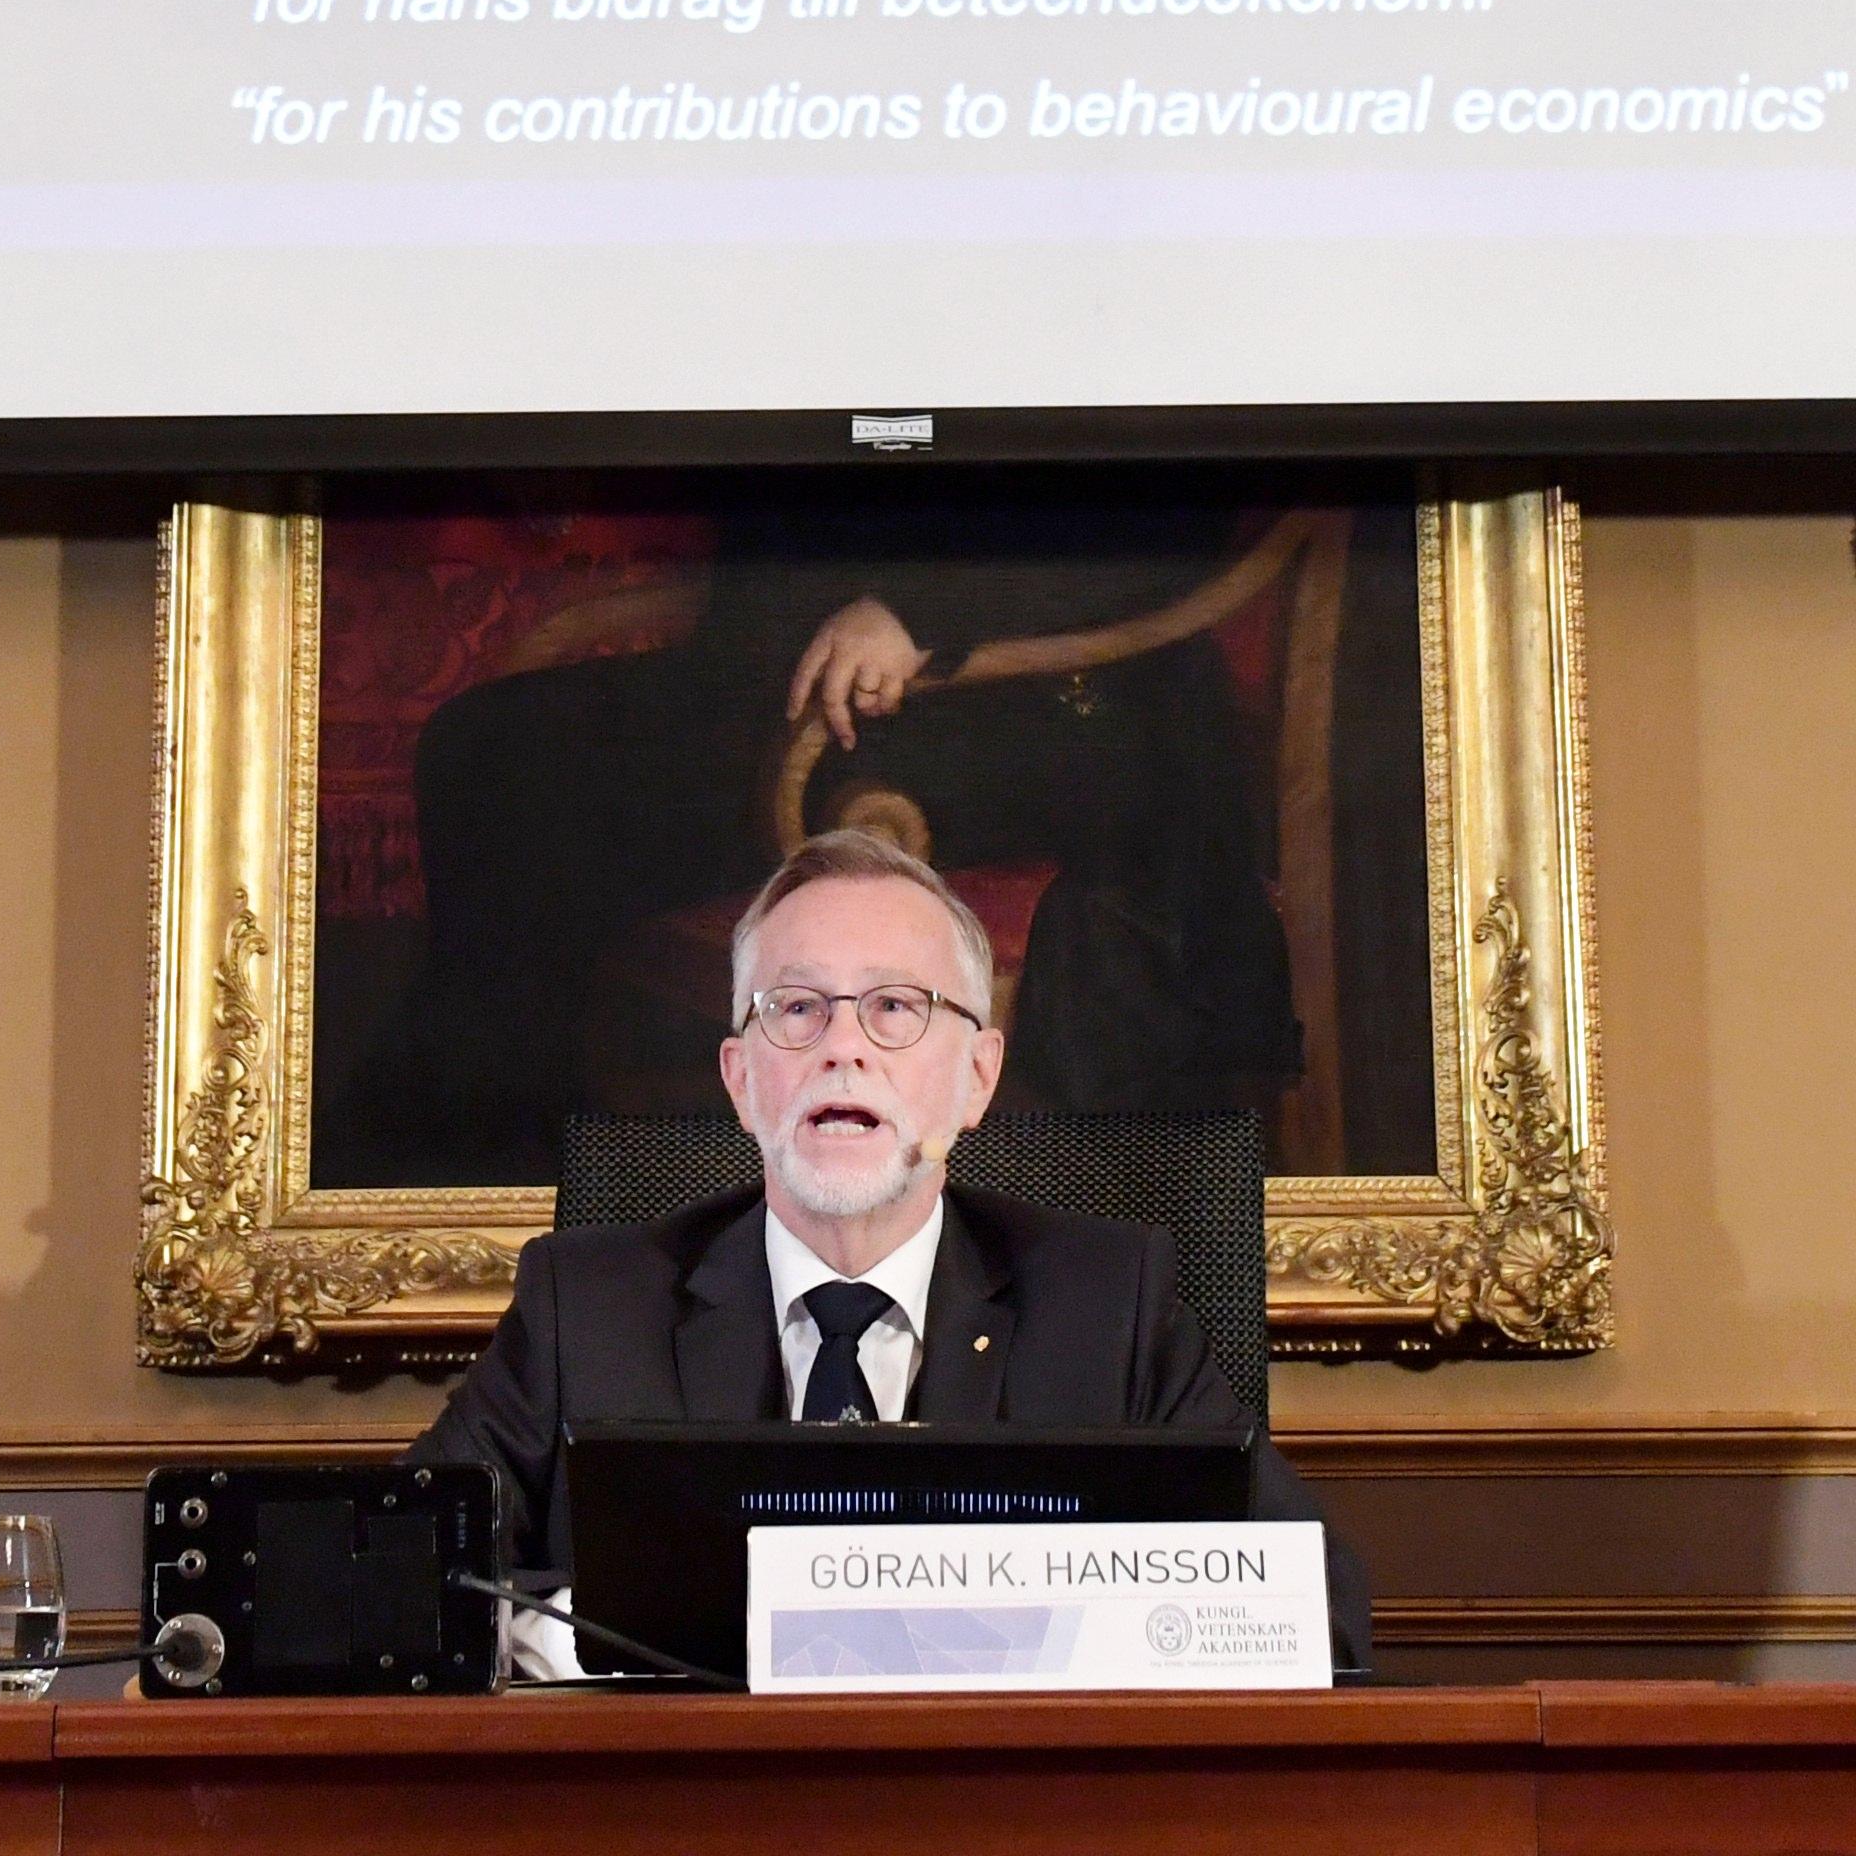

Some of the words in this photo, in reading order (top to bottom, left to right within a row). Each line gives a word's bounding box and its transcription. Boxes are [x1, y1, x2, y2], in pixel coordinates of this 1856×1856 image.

[362, 84, 463, 144] his
[484, 80, 923, 143] contributions
[944, 82, 1008, 139] to
[1029, 74, 1434, 138] behavioural
[810, 1546, 968, 1590] GÖRAN
[987, 1551, 1027, 1587] K.
[1046, 1549, 1266, 1586] HANSSON
